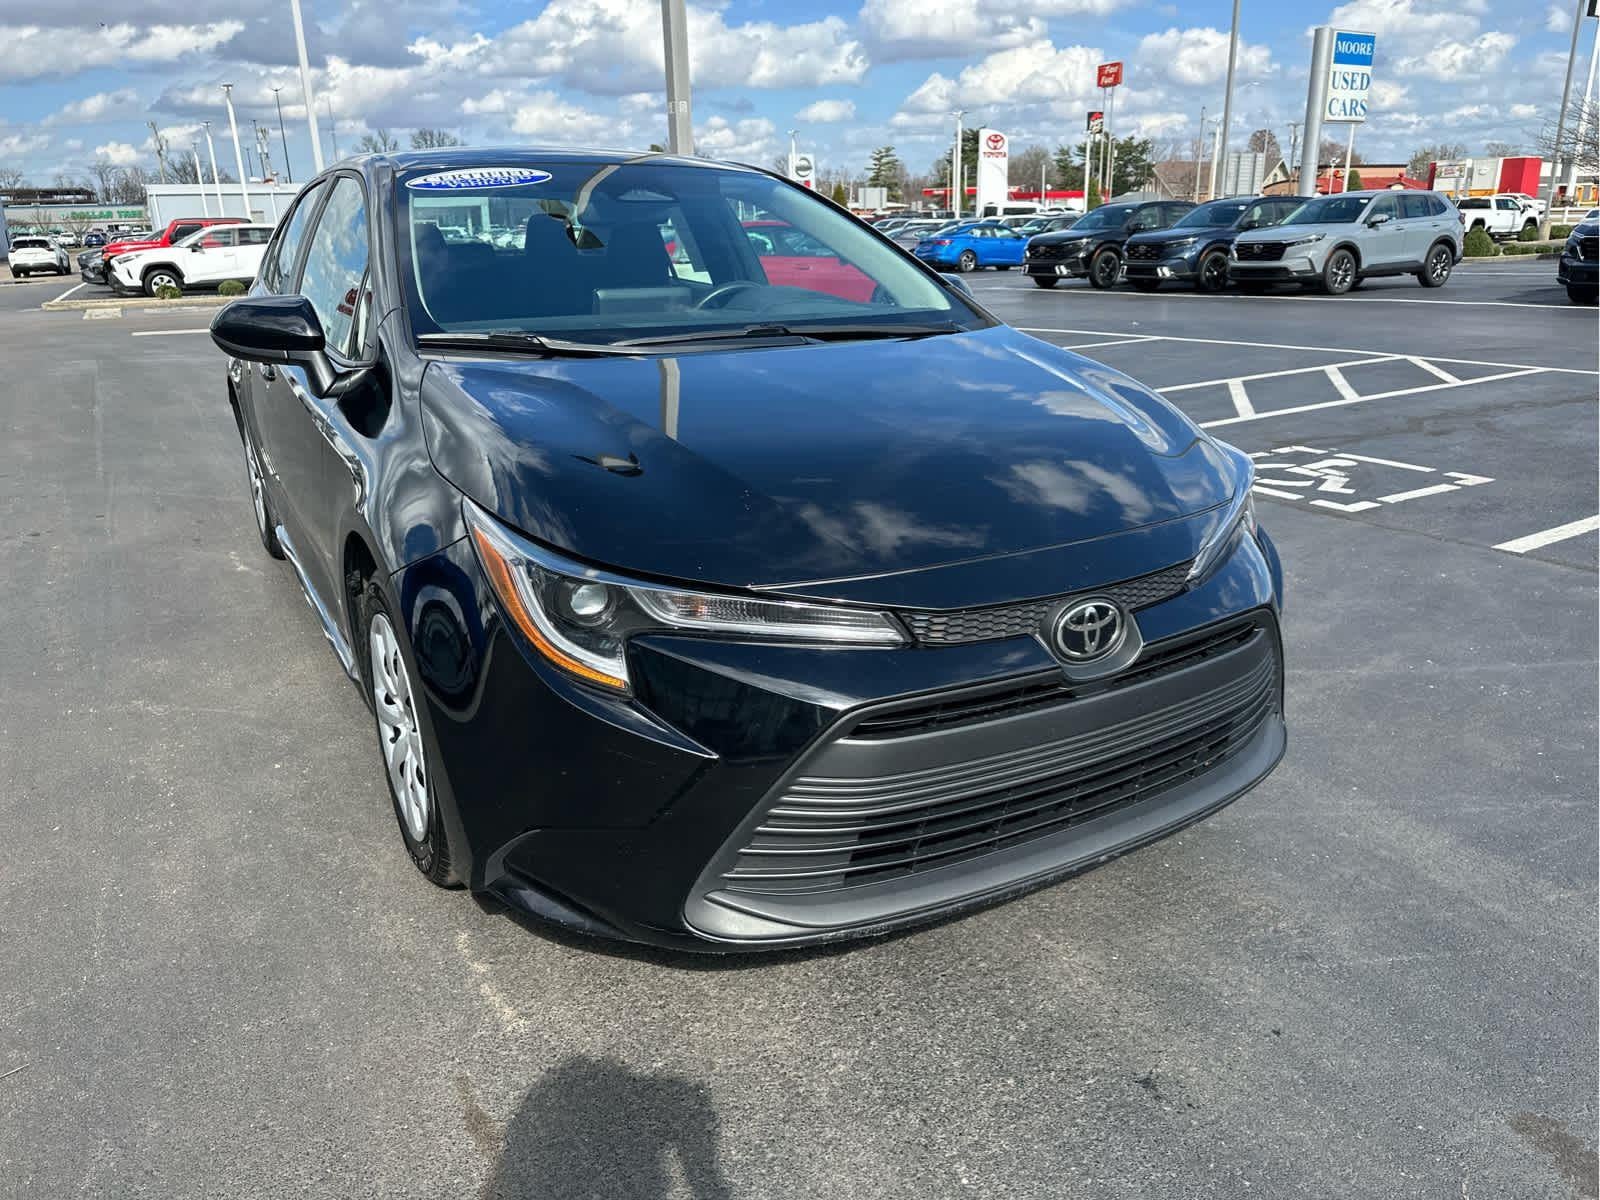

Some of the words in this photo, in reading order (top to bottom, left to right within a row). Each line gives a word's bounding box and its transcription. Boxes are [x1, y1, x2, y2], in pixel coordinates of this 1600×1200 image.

[1337, 41, 1373, 55] MOORE
[1332, 71, 1371, 90] USED
[1328, 97, 1368, 117] CARS
